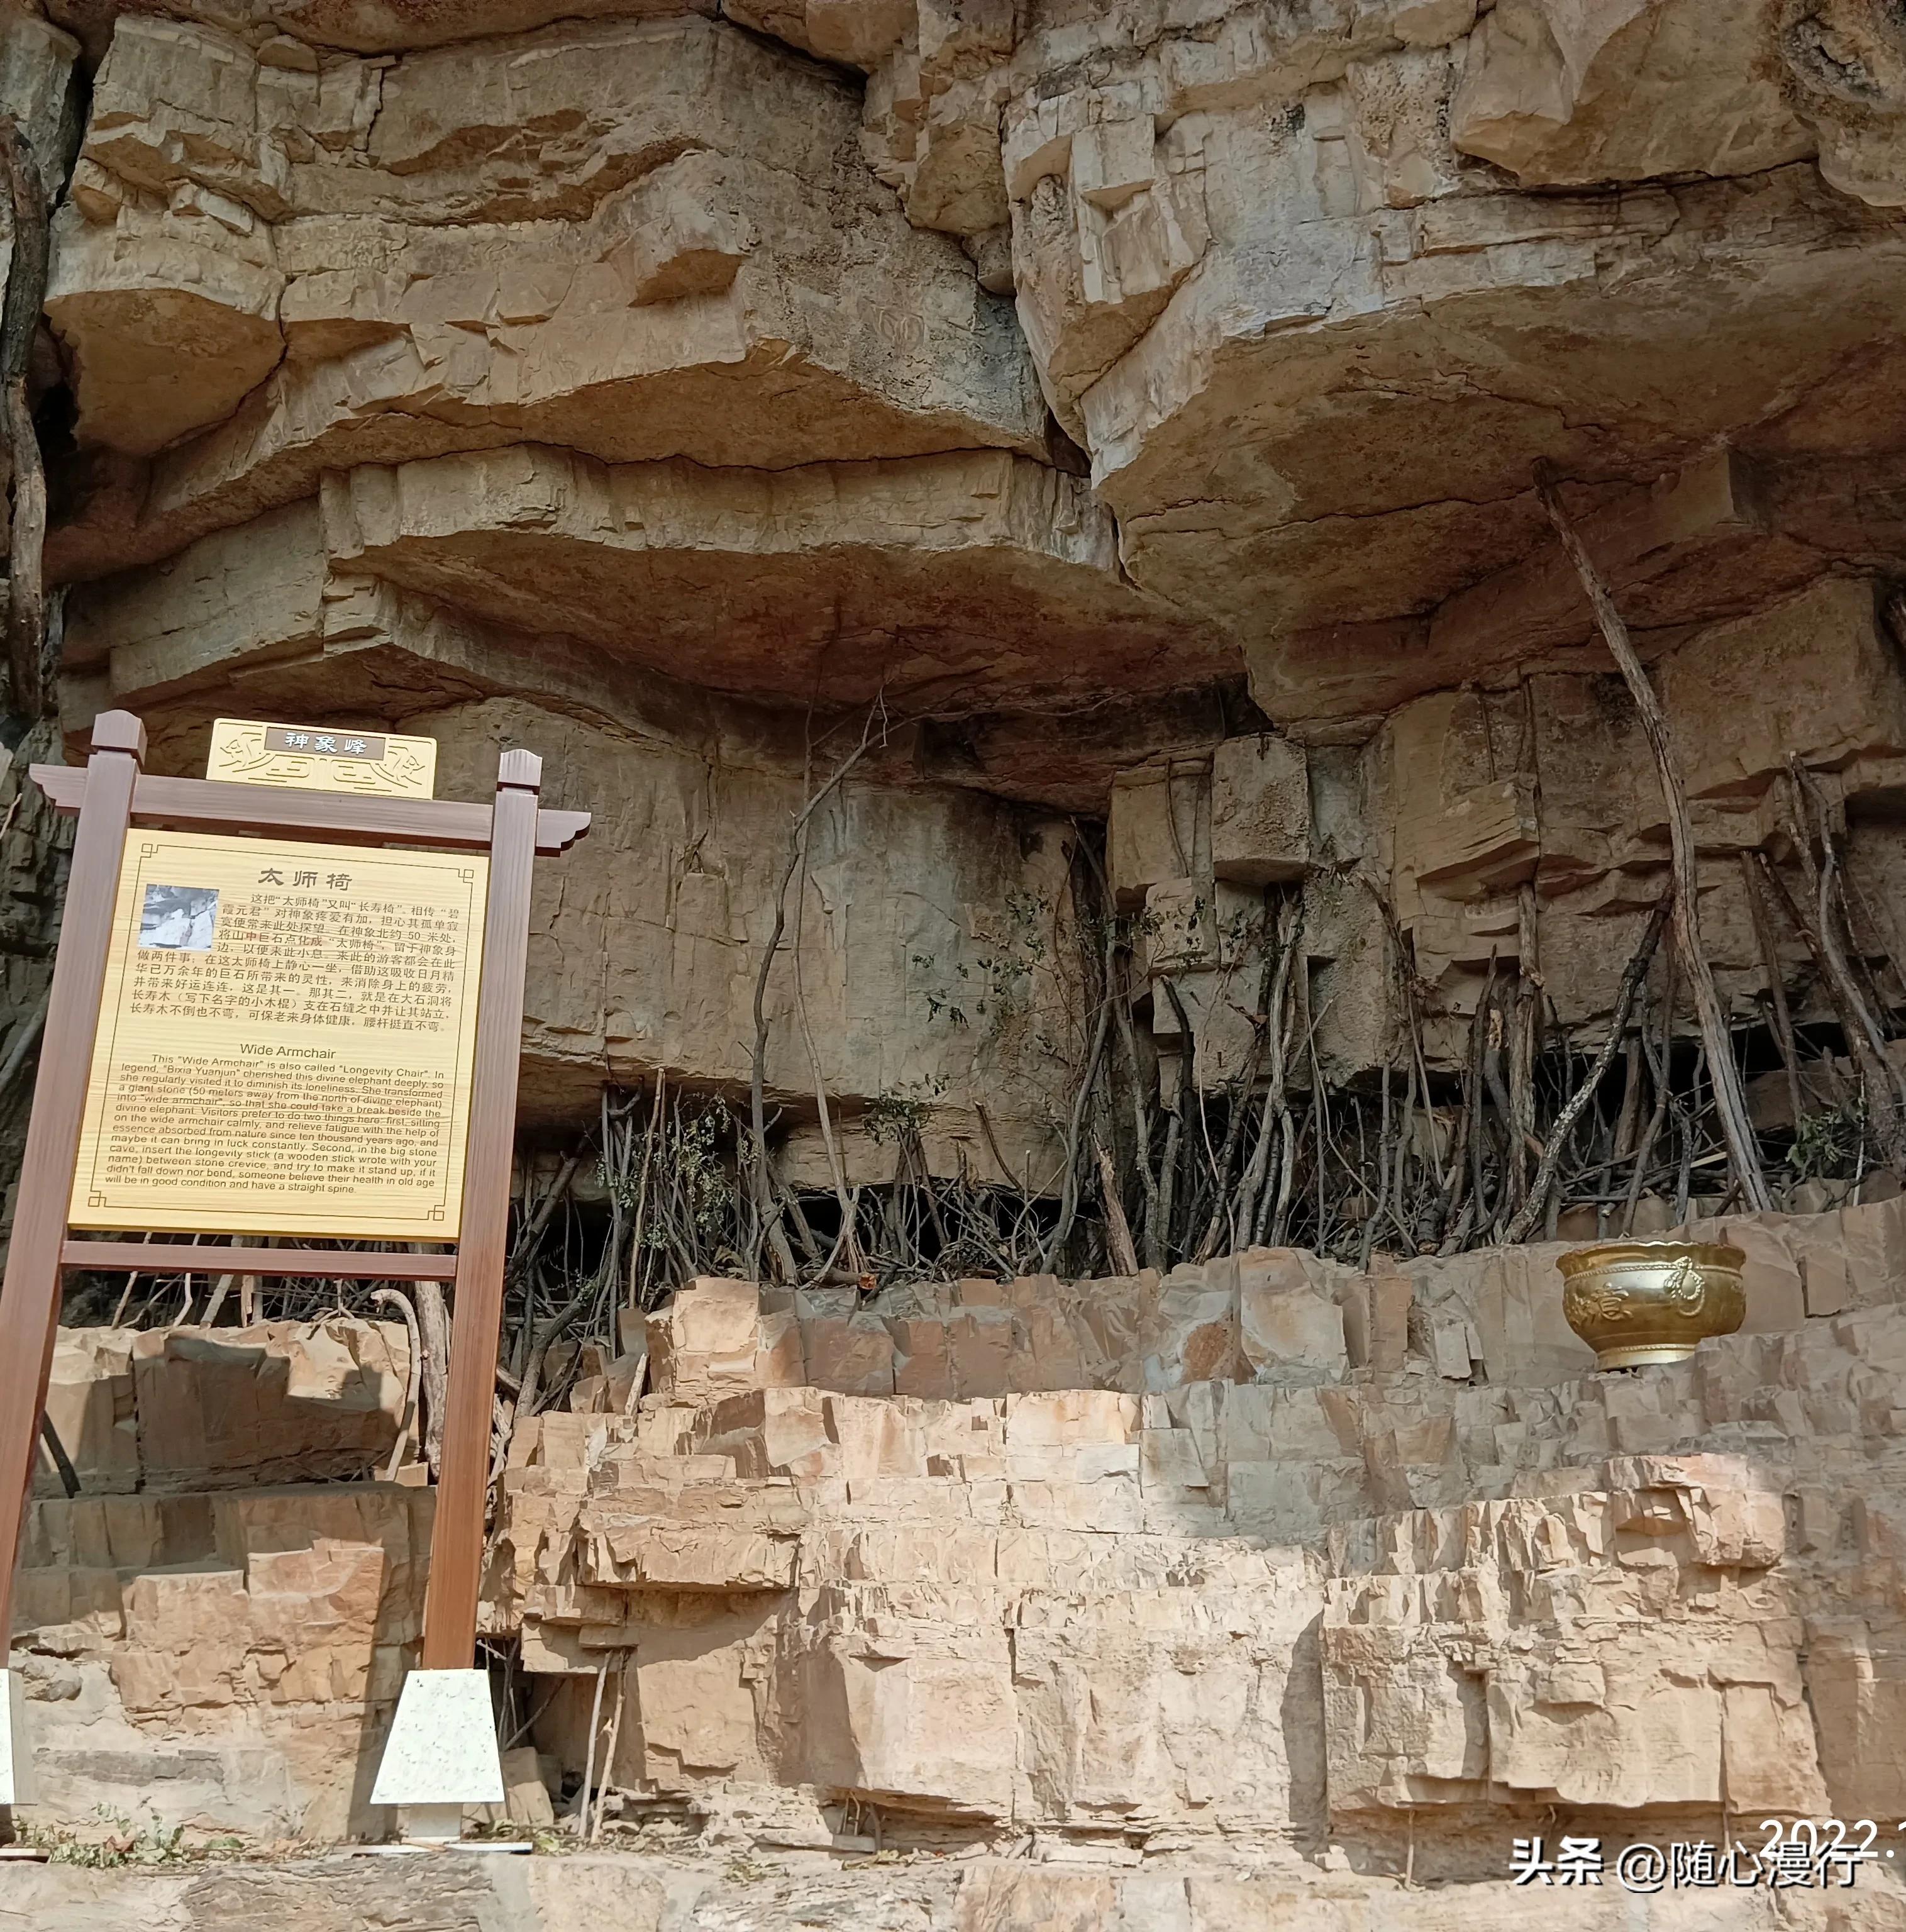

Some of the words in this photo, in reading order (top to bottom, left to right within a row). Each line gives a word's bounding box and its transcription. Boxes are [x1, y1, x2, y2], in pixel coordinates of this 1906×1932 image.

[285, 731, 367, 755] 神象峰
[257, 867, 353, 891] 太师椅
[240, 1043, 274, 1055] Wide
[276, 1045, 336, 1058] Armchair
[151, 1054, 174, 1063] This
[267, 1060, 275, 1069] is
[279, 1061, 301, 1070] also
[304, 1063, 335, 1072] called
[435, 1070, 444, 1078] In
[243, 1069, 292, 1079] cherished
[295, 1072, 313, 1080] this
[316, 1073, 346, 1082] divine
[348, 1075, 391, 1087] elephant
[120, 1072, 139, 1081] she
[141, 1074, 186, 1085] regularly
[189, 1076, 221, 1085] visited
[246, 1079, 288, 1089] diminish
[291, 1082, 302, 1090] its
[361, 1085, 382, 1094] She
[384, 1087, 443, 1097] transformed
[127, 1083, 154, 1094] giant
[157, 1085, 187, 1094] stone
[188, 1086, 206, 1096] (50
[208, 1087, 243, 1097] meters
[246, 1091, 274, 1100] away
[274, 1091, 299, 1099] from
[301, 1092, 319, 1101] the
[321, 1093, 347, 1102] north
[362, 1095, 392, 1104] divine
[395, 1097, 442, 1109] elephant)
[115, 1102, 147, 1112] divine
[200, 1107, 239, 1116] Visitors
[241, 1109, 272, 1120] prefer
[411, 1118, 440, 1128] sitting
[116, 1092, 137, 1101] into
[289, 1101, 318, 1111] could
[321, 1103, 343, 1112] take
[356, 1104, 385, 1114] break
[388, 1106, 422, 1116] beside
[424, 1108, 441, 1117] the
[112, 1124, 155, 1133] essence
[158, 1125, 206, 1135] absorbed
[207, 1127, 232, 1136] from
[235, 1130, 267, 1138] nature
[269, 1130, 296, 1140] since
[299, 1132, 314, 1140] ten
[317, 1133, 363, 1143] thousand
[365, 1136, 393, 1146] years
[419, 1138, 438, 1146] and
[130, 1113, 147, 1122] the
[150, 1114, 175, 1123] wide
[177, 1116, 224, 1126] armchair
[287, 1121, 322, 1131] relieve
[324, 1123, 360, 1135] fatigue
[362, 1125, 383, 1134] with
[386, 1126, 404, 1135] the
[404, 1127, 428, 1138] help
[429, 1128, 440, 1136] of
[110, 1133, 147, 1145] maybe
[150, 1135, 157, 1143] it
[183, 1136, 211, 1147] bring
[214, 1138, 223, 1146] in
[226, 1138, 248, 1147] luck
[357, 1145, 367, 1153] in
[370, 1145, 387, 1153] the
[389, 1146, 406, 1157] big
[408, 1148, 437, 1156] stone
[141, 1145, 172, 1154] insert
[175, 1146, 192, 1155] the
[194, 1147, 243, 1159] longevity
[246, 1150, 271, 1158] stick
[273, 1151, 284, 1161] (a
[287, 1152, 328, 1161] wooden
[331, 1153, 355, 1162] stick
[358, 1155, 387, 1163] wrote
[389, 1156, 411, 1165] with
[413, 1159, 436, 1168] your
[106, 1163, 135, 1173] didn't
[137, 1165, 153, 1174] fall
[155, 1166, 184, 1175] down
[238, 1171, 285, 1179] someone
[288, 1172, 324, 1181] believe
[327, 1173, 350, 1182] their
[352, 1174, 384, 1184] health
[386, 1176, 395, 1184] in
[397, 1176, 413, 1185] old
[416, 1179, 435, 1187] age
[107, 1153, 143, 1165] name)
[145, 1155, 192, 1165] between
[194, 1158, 224, 1167] stone
[273, 1161, 293, 1170] and
[296, 1162, 311, 1172] try
[313, 1163, 324, 1171] to
[326, 1163, 356, 1172] make
[358, 1165, 365, 1173] it
[368, 1165, 397, 1174] stand
[419, 1167, 427, 1175] if
[429, 1168, 436, 1176] it
[104, 1174, 121, 1183] will
[123, 1175, 137, 1184] be
[140, 1175, 150, 1184] in
[151, 1176, 178, 1187] good
[180, 1177, 226, 1187] condition
[228, 1179, 248, 1188] and
[251, 1180, 275, 1189] have
[287, 1182, 325, 1193] straight
